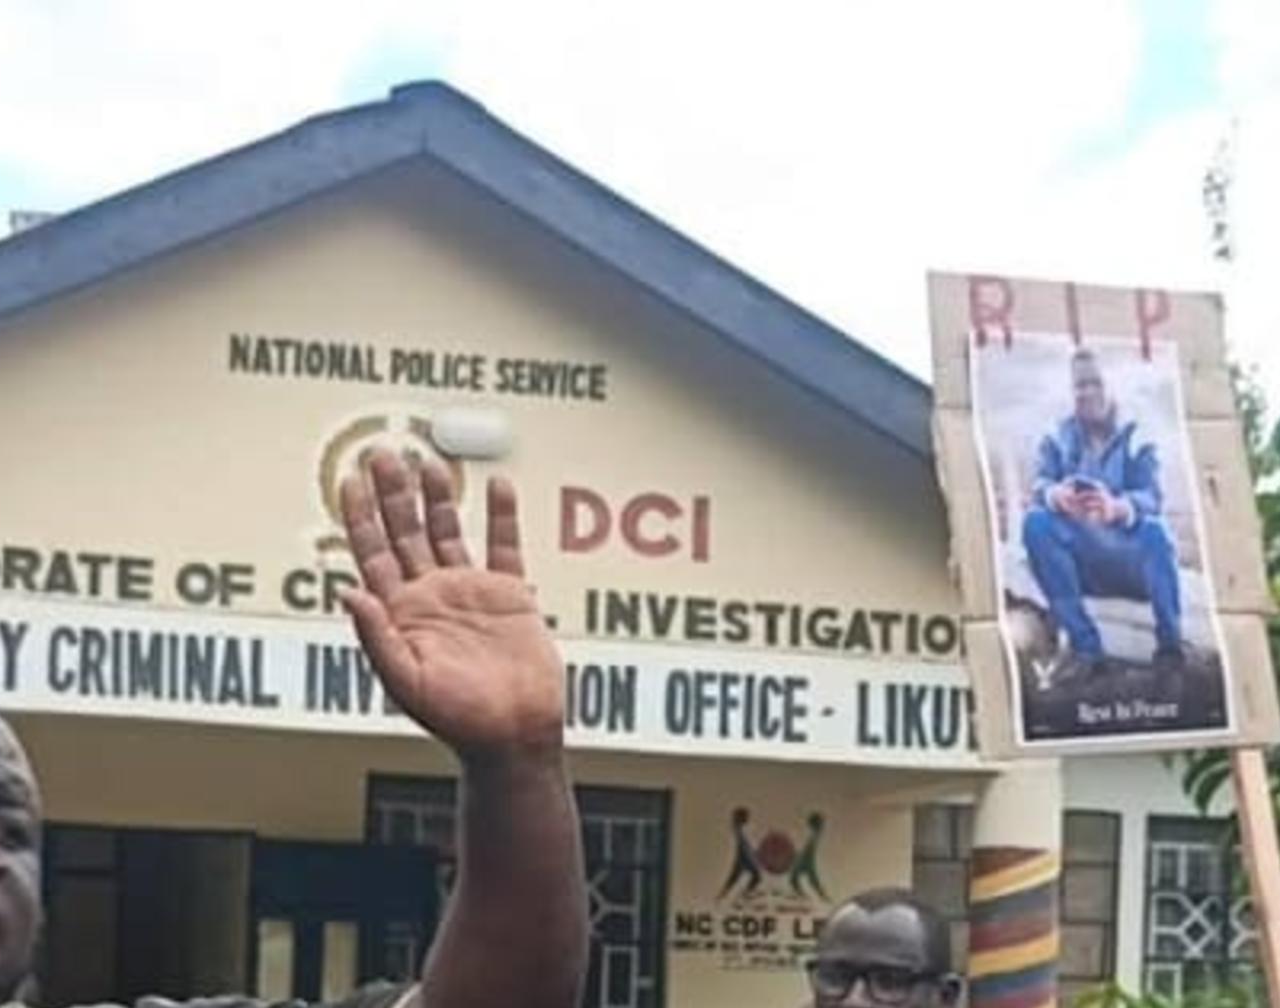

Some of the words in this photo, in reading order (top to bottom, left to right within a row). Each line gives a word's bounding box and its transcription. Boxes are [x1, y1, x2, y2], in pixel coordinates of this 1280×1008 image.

[229, 334, 382, 383] NATIONAL
[390, 348, 486, 392] POLICE
[495, 357, 608, 400] SERVICE
[559, 486, 711, 562] DCI
[175, 563, 255, 607] OF
[47, 626, 279, 708] CRIMINAL
[665, 669, 809, 743] OFFICE
